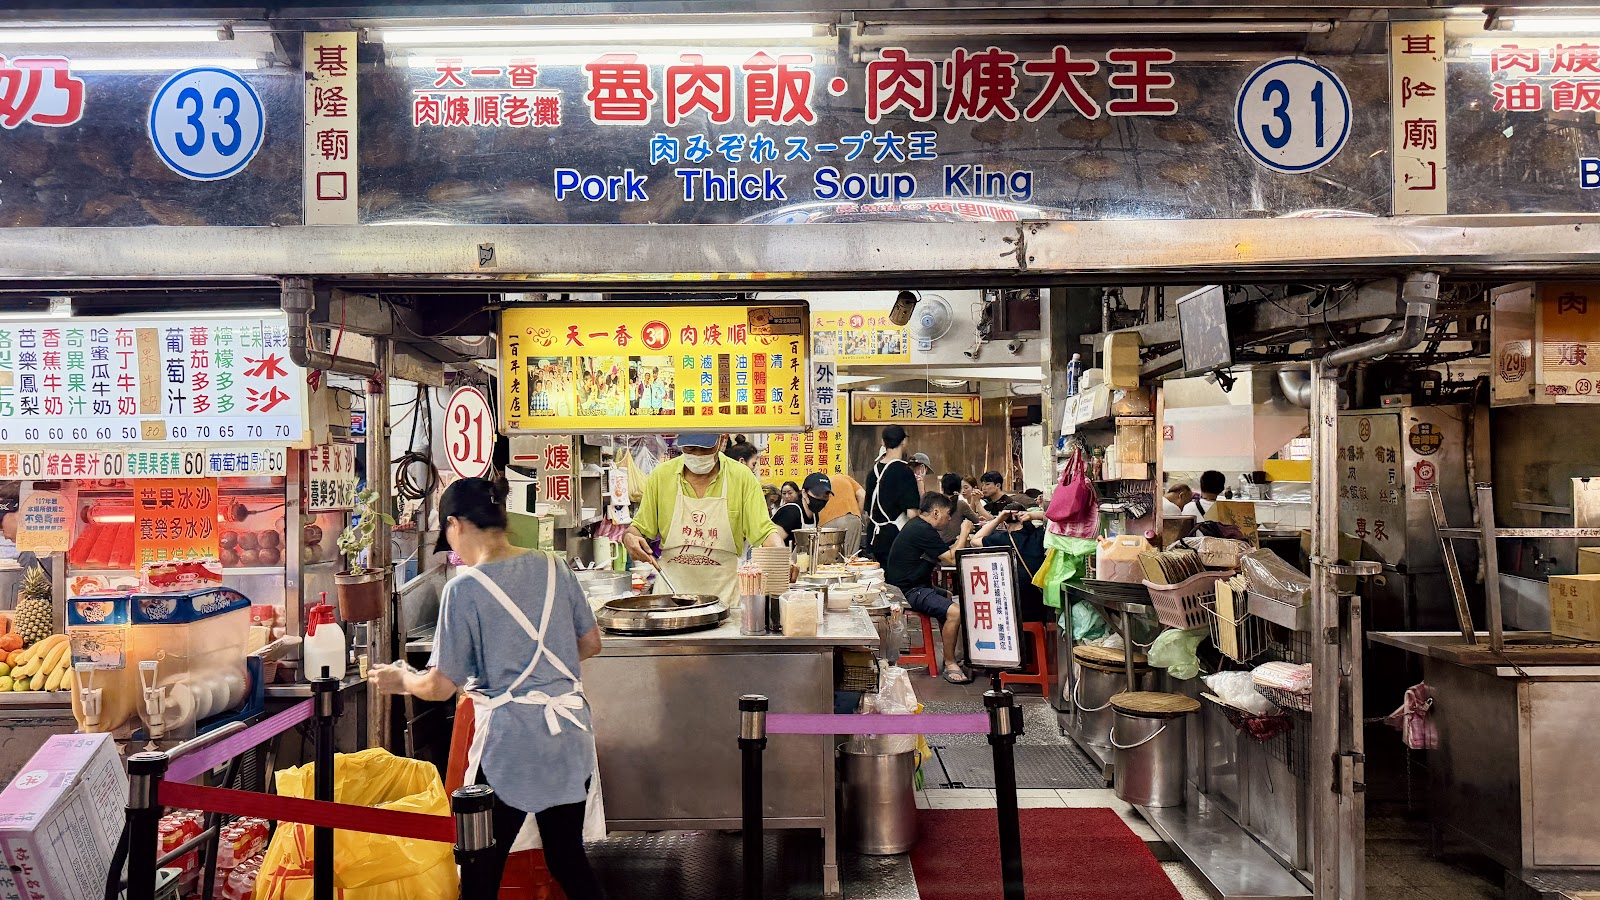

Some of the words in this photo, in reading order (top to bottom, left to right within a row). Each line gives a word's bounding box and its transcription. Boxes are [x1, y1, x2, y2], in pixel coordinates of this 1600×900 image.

[434, 58, 538, 87] 天一香
[175, 87, 242, 157] 33
[314, 44, 348, 200] 基隆廟口
[414, 95, 560, 126] 肉焿順老攤
[1262, 79, 1324, 148] 31
[651, 132, 938, 164] 肉みぞれスープ大王
[555, 170, 648, 201] Pork
[677, 169, 786, 201] Thick
[814, 167, 916, 201] Soup
[944, 165, 1034, 201] King
[564, 325, 634, 348] 天一香
[644, 328, 669, 346] 31
[680, 323, 748, 346] 肉焿順
[851, 317, 862, 327] 31
[868, 317, 894, 327] 肉焿
[18, 328, 40, 416] 芭樂鳳梨
[42, 328, 63, 415] 香蕉牛奶
[66, 328, 87, 415] 奇異果汁
[90, 328, 111, 415] 哈蜜瓜牛奶
[115, 328, 137, 415] 布丁牛奶
[165, 327, 187, 414] 葡萄汁
[214, 326, 235, 413] 檸檬多多
[242, 352, 291, 413] 冰沙
[683, 354, 696, 403] 肉焿
[700, 354, 713, 403] 滷肉飯
[735, 354, 748, 403] 油豆腐
[770, 354, 784, 403] 清飯
[1506, 353, 1520, 372] 29
[816, 364, 834, 427] 外帶區
[1579, 382, 1589, 392] 29
[702, 406, 713, 415] 25
[755, 405, 765, 414] 20
[772, 405, 783, 414] 15
[1360, 422, 1370, 437] 29
[25, 428, 39, 441] 60
[48, 427, 63, 440] 60
[72, 427, 88, 440] 60
[96, 427, 111, 440] 60
[122, 427, 137, 439] 50
[172, 426, 187, 439] 60
[196, 426, 210, 438] 70
[219, 426, 234, 438] 65
[247, 425, 262, 437] 70
[275, 425, 290, 437] 70
[453, 404, 485, 464] 31
[22, 454, 41, 477] 60
[47, 452, 101, 476] 綜合果汁
[104, 453, 123, 476] 60
[127, 452, 181, 475] 奇異果香蕉
[184, 452, 204, 475] 60
[209, 450, 267, 473] 葡萄柚原汁
[269, 451, 283, 472] 50
[544, 434, 571, 501] 焿順
[760, 468, 770, 476] 25
[775, 468, 784, 476] 15
[141, 487, 212, 510] 芒果冰沙
[140, 516, 213, 540] 養樂多冰沙
[1355, 517, 1389, 541] 專家
[970, 566, 992, 630] 內用
